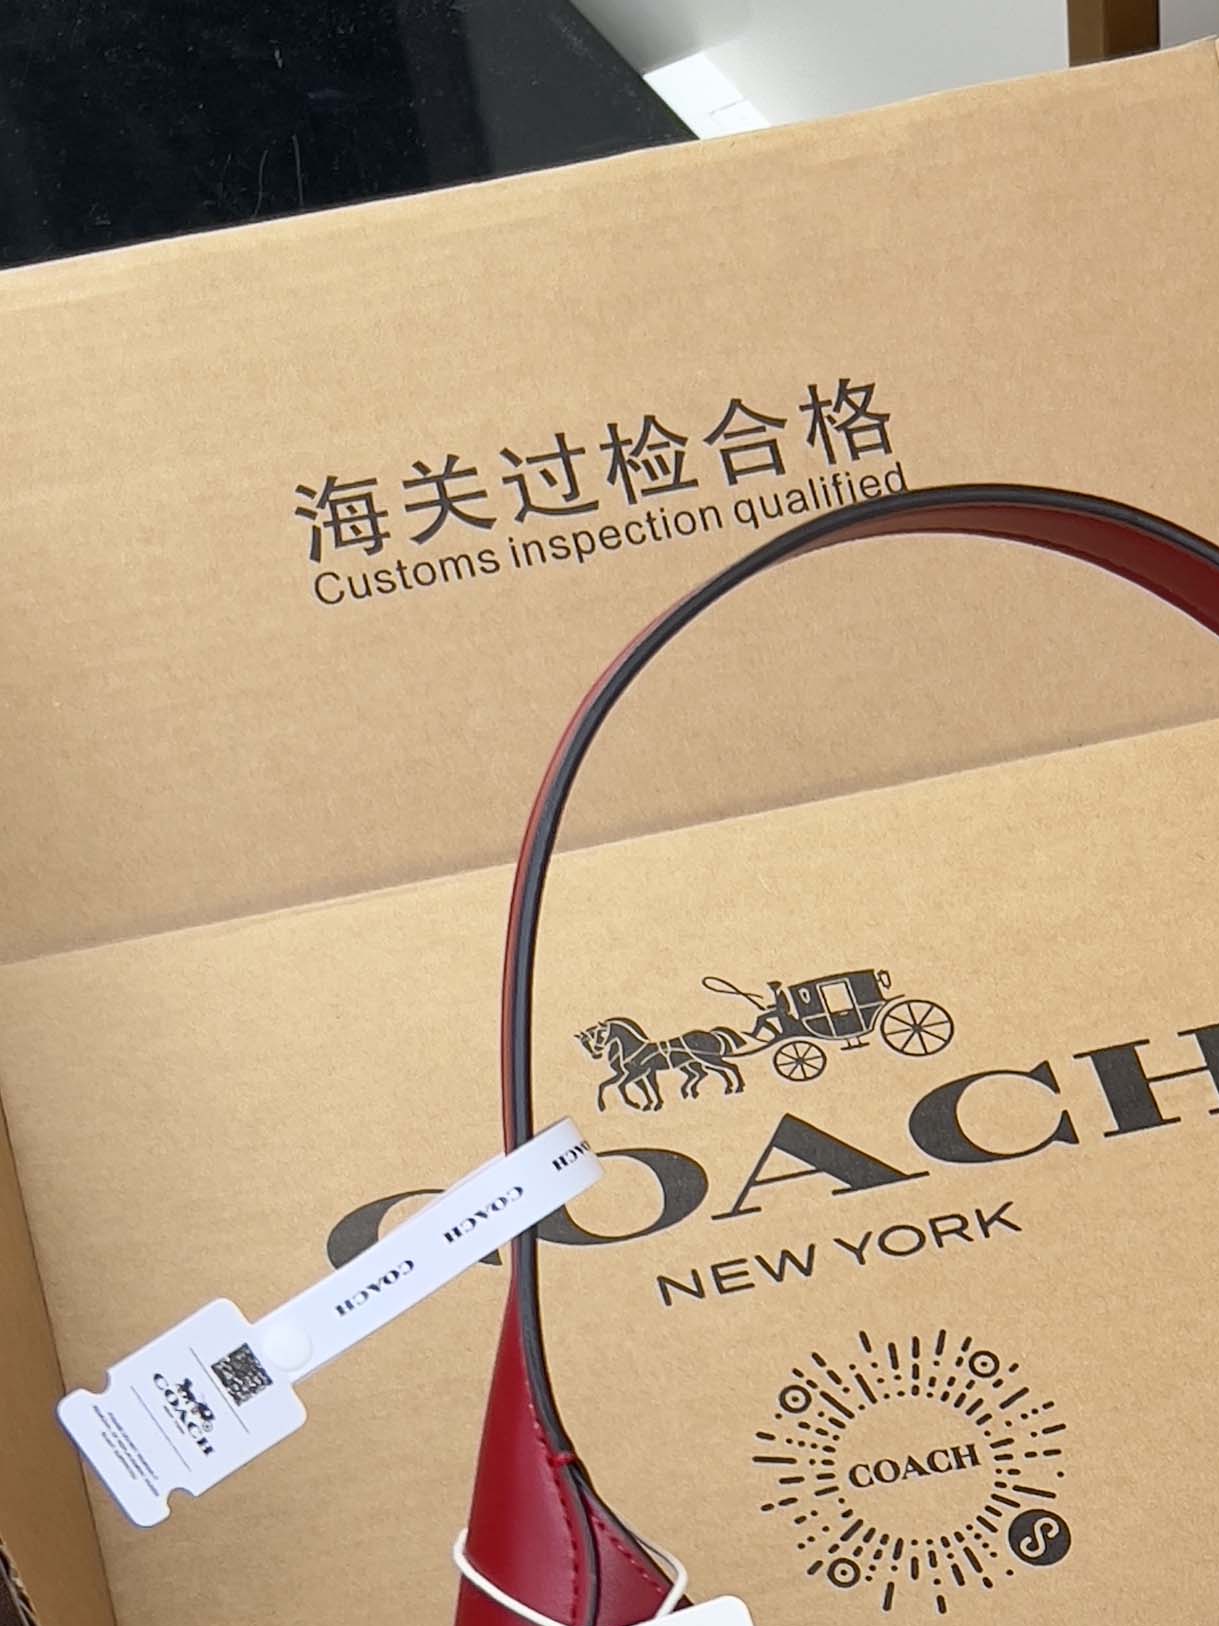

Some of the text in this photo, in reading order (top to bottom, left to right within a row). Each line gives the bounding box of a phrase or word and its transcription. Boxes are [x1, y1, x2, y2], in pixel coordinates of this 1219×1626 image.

[294, 377, 894, 564] 海关过检合格
[313, 461, 909, 606] Customs inspection qualified
[442, 1185, 525, 1244] COACH
[655, 1201, 1024, 1307] NEW YORK
[334, 1258, 415, 1318] COACH
[151, 1371, 215, 1456] COACH
[847, 1443, 982, 1488] COACH
